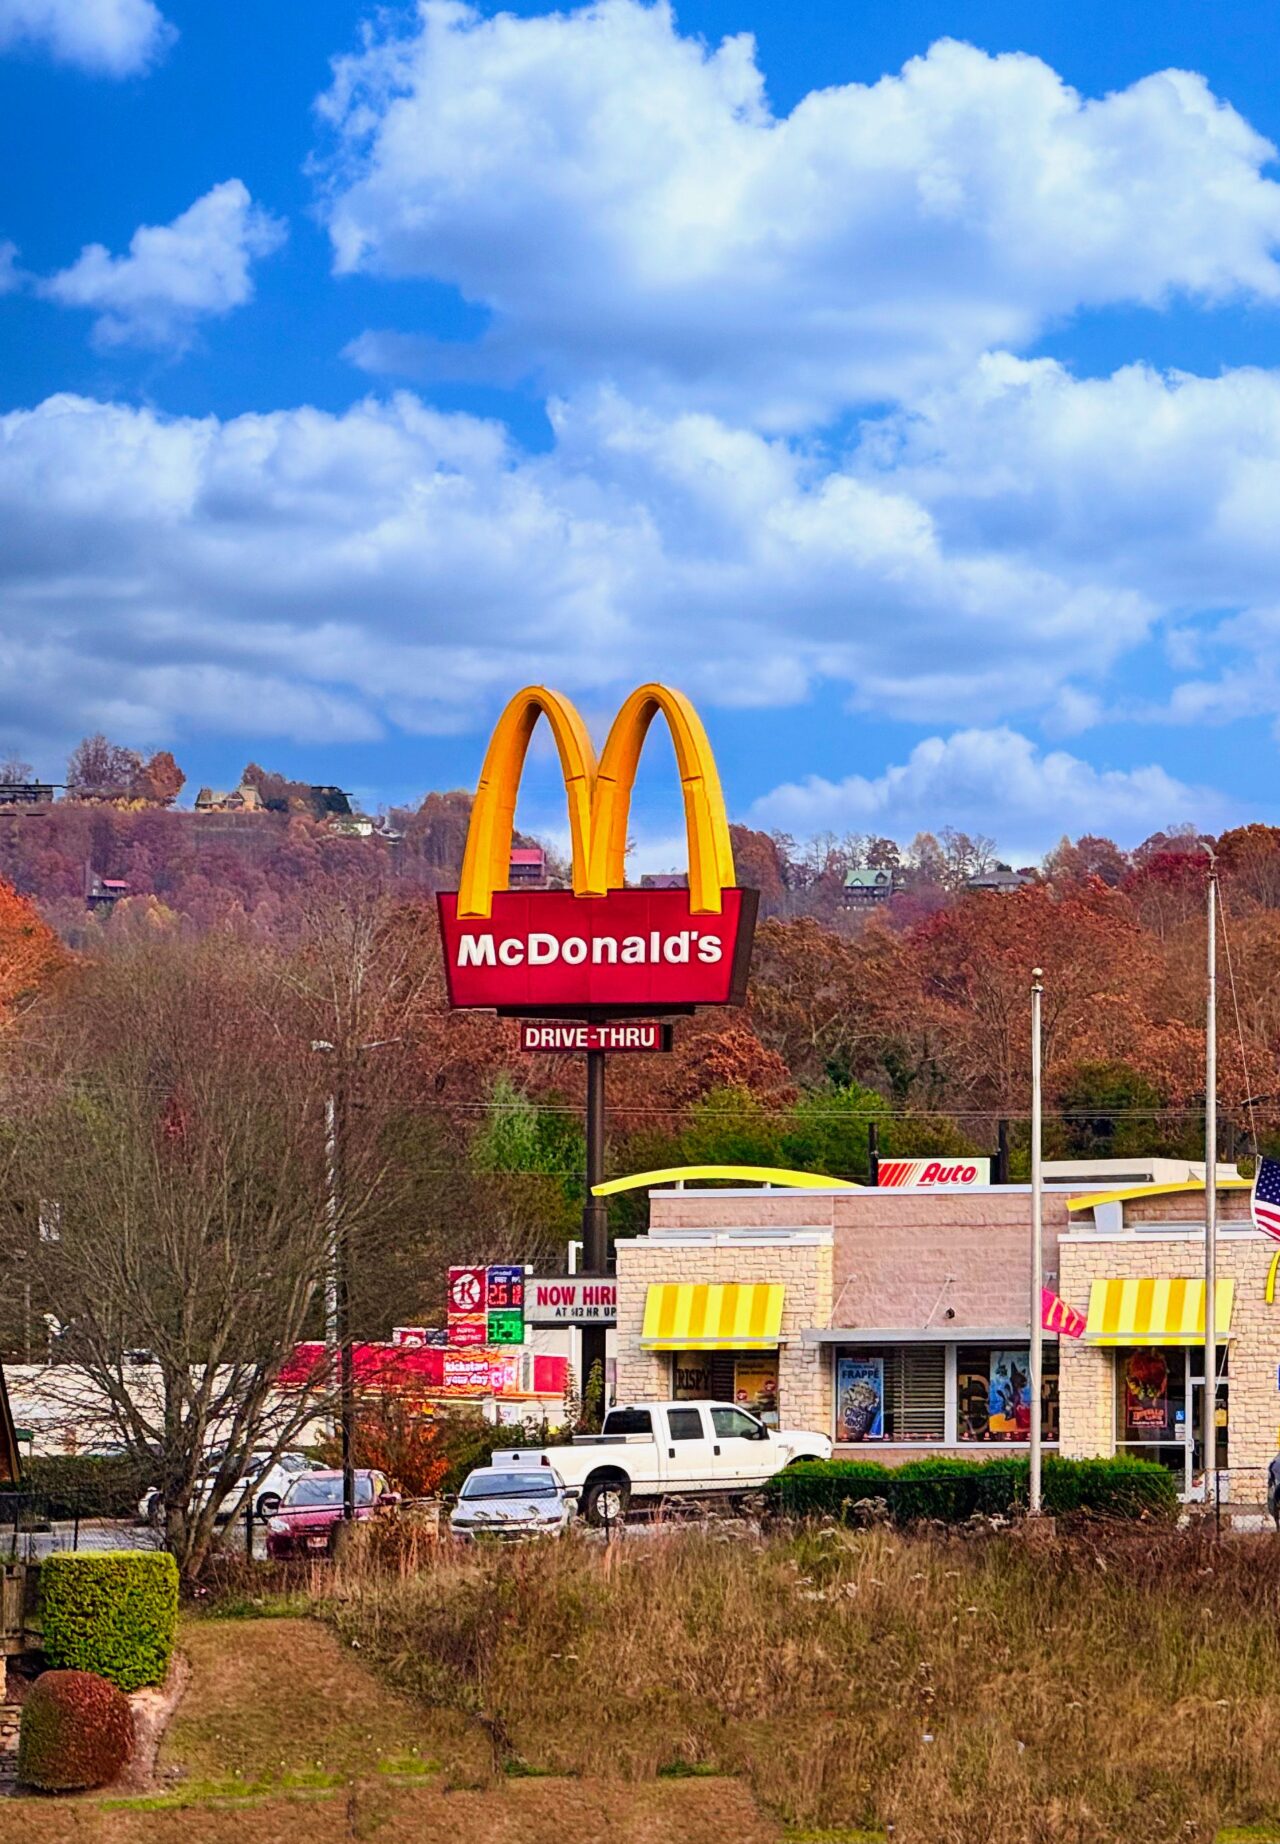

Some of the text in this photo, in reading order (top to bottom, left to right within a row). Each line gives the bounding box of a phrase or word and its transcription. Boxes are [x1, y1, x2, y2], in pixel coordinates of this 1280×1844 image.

[457, 931, 722, 967] McDonald's
[525, 1027, 655, 1048] DRIVE-THRU
[918, 1162, 978, 1183] Auto
[537, 1286, 576, 1306] NOW
[555, 1307, 567, 1317] AT
[586, 1307, 599, 1317] HR
[604, 1307, 616, 1316] UP
[445, 1361, 489, 1372] kickstart
[445, 1374, 489, 1386] your day
